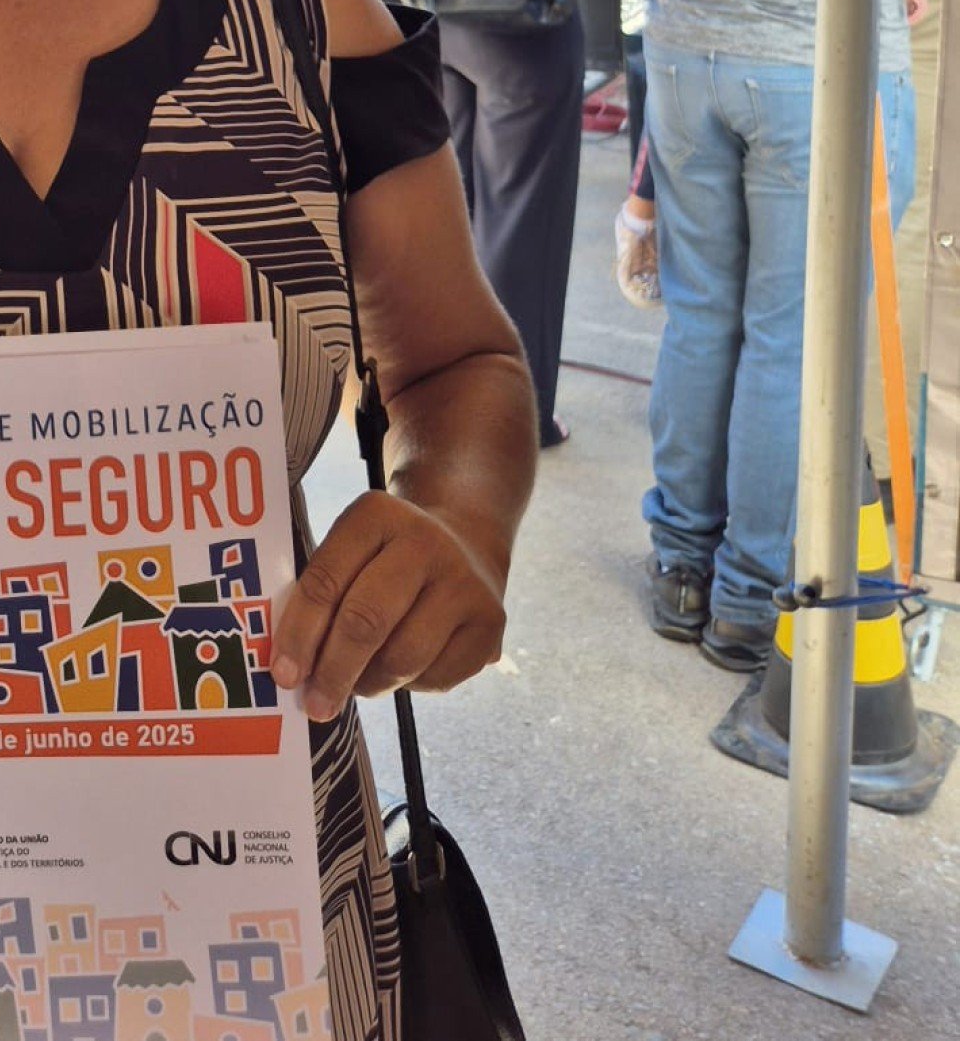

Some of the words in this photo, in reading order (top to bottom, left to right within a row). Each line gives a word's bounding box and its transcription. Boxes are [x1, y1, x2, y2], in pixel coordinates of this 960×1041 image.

[30, 393, 264, 440] MOBILIZAÇÃO
[5, 446, 265, 539] SEGURO
[24, 728, 92, 755] junho
[101, 725, 129, 747] de
[137, 724, 195, 746] 2025
[5, 836, 18, 844] DA
[20, 834, 49, 843] UNIÃO
[242, 830, 291, 840] CONSELHO
[164, 830, 237, 866] CNJ
[243, 843, 290, 852] NACIONAL
[10, 860, 28, 868] DOS
[31, 857, 85, 868] TERRITÓRIOS
[245, 855, 256, 865] DE
[258, 855, 294, 866] JUSTIÇA
